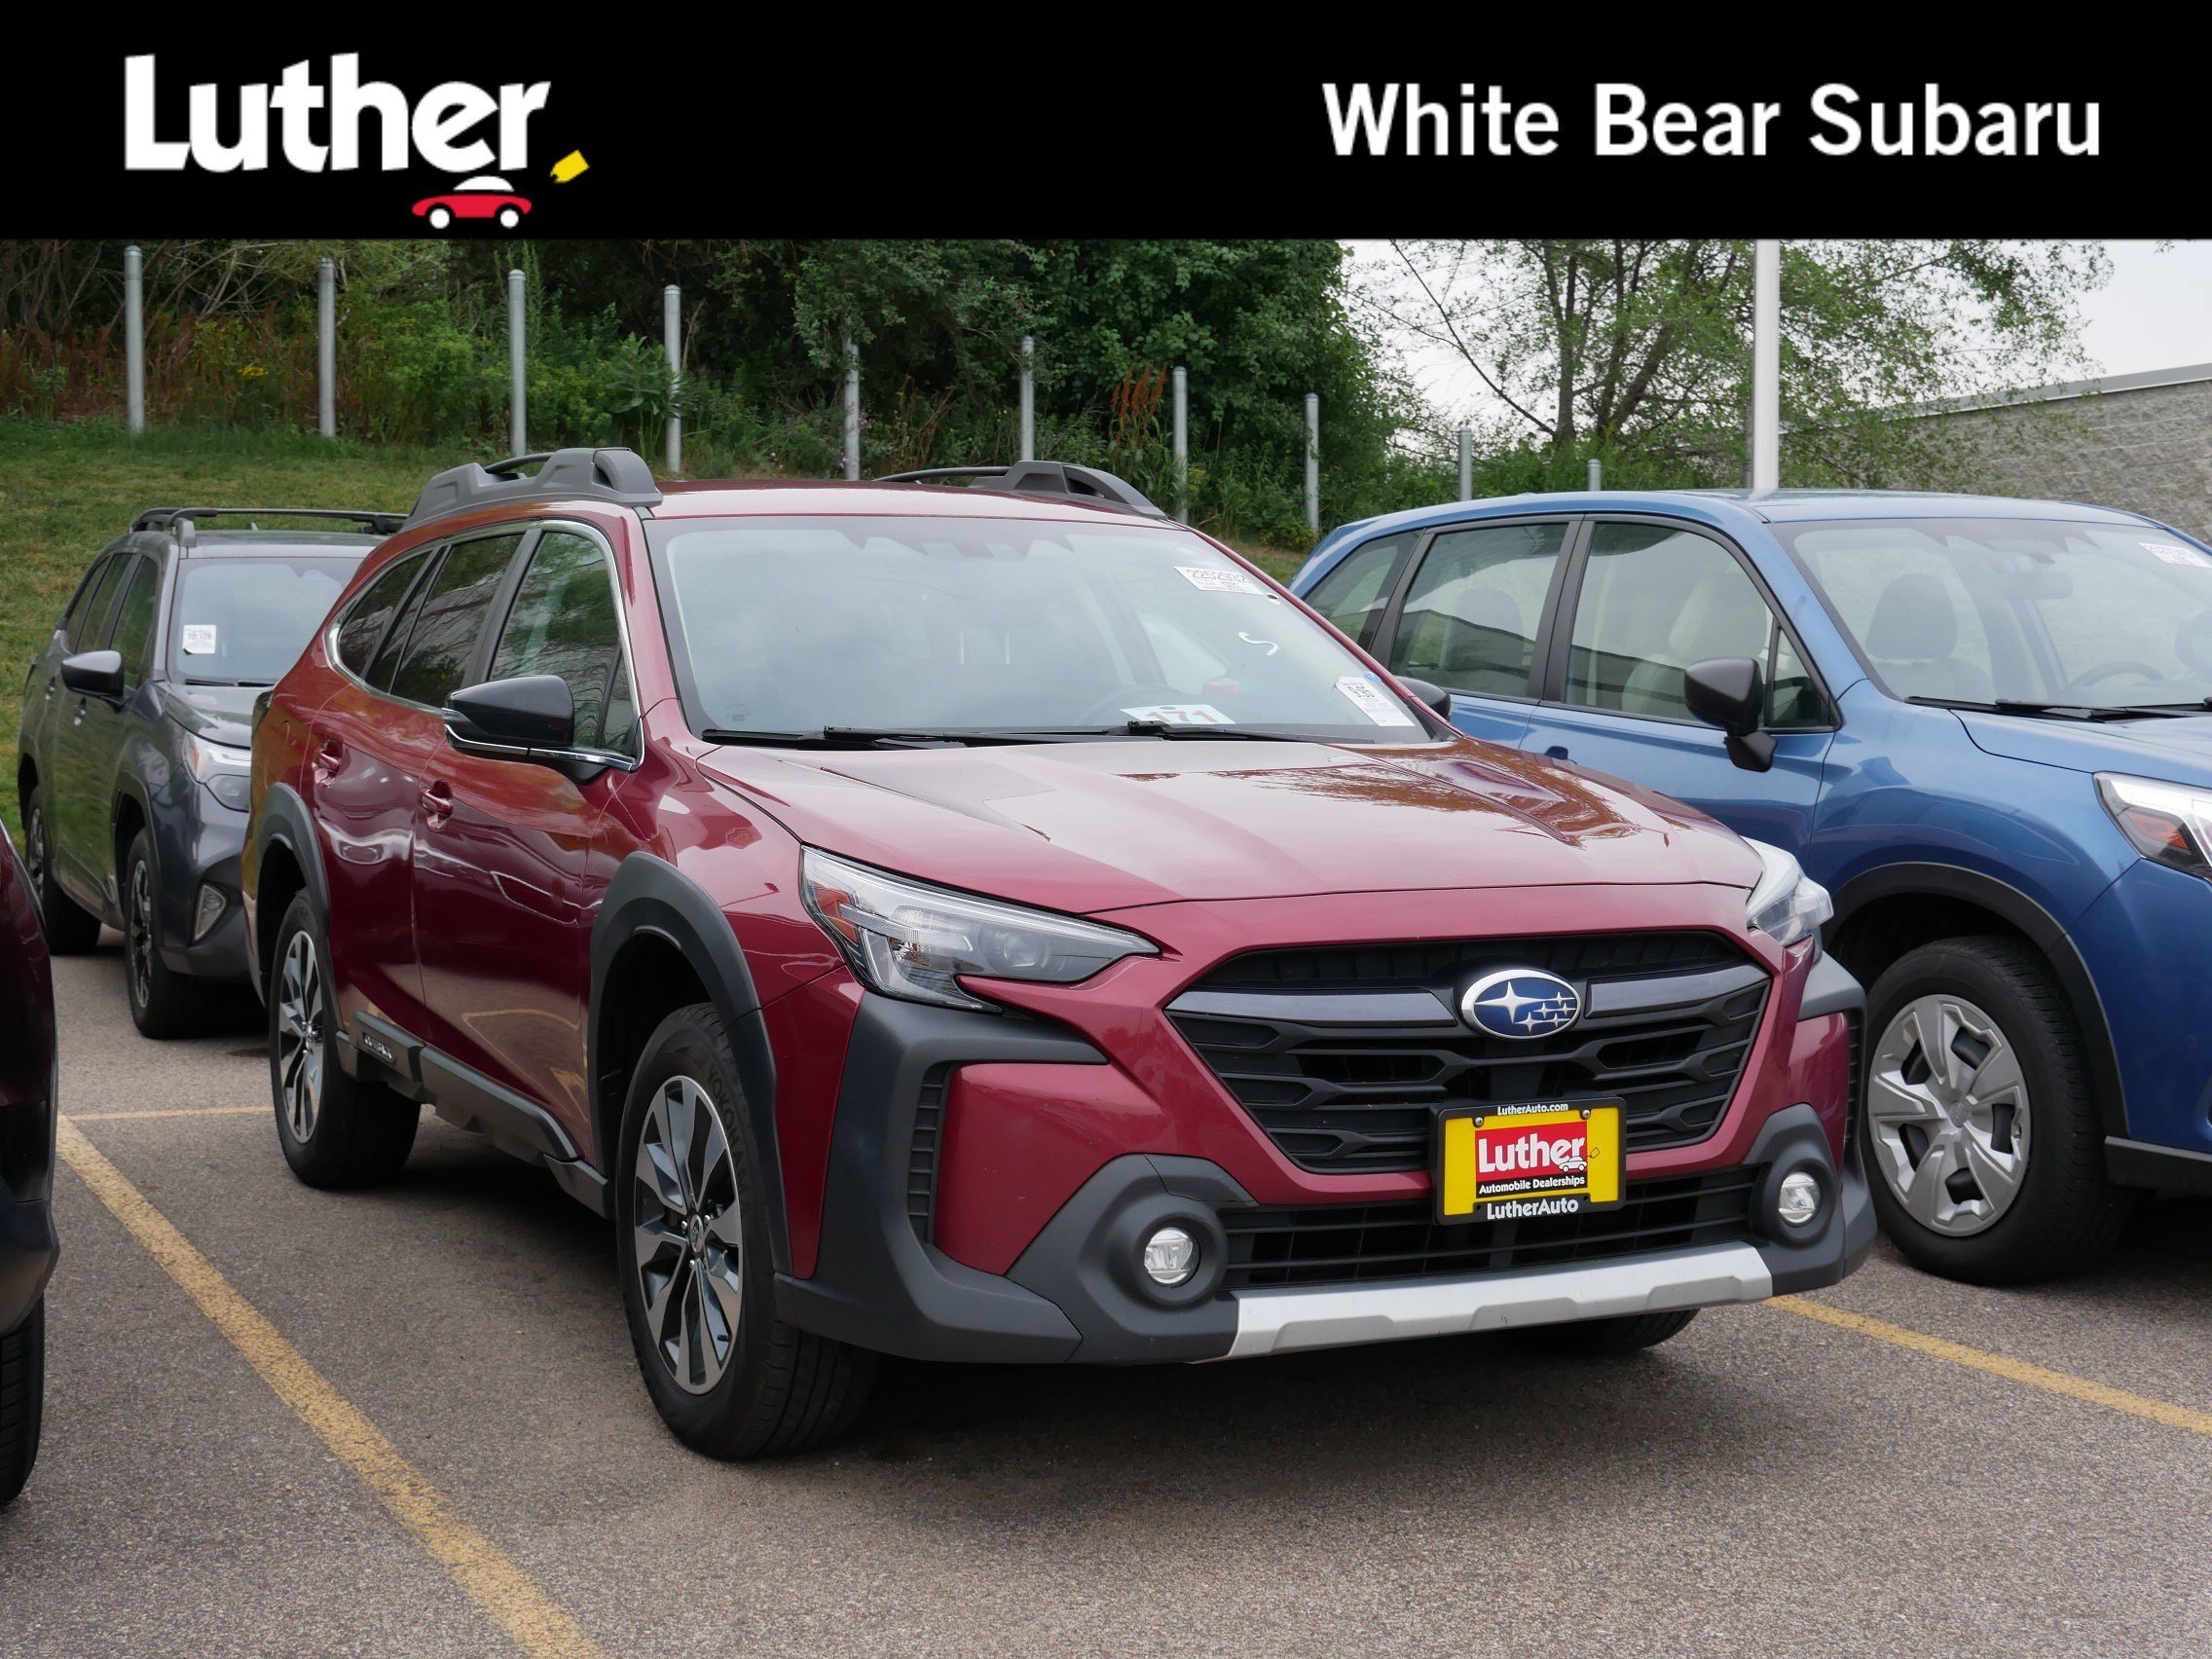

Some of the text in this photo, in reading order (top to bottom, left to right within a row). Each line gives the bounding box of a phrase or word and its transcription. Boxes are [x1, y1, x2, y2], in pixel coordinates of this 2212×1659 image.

[1496, 1102, 1568, 1116] LutherAuto.com
[1478, 1132, 1586, 1173] Luther
[1478, 1175, 1586, 1195] Automobile Dealerships
[1487, 1197, 1579, 1220] LutherAuto
